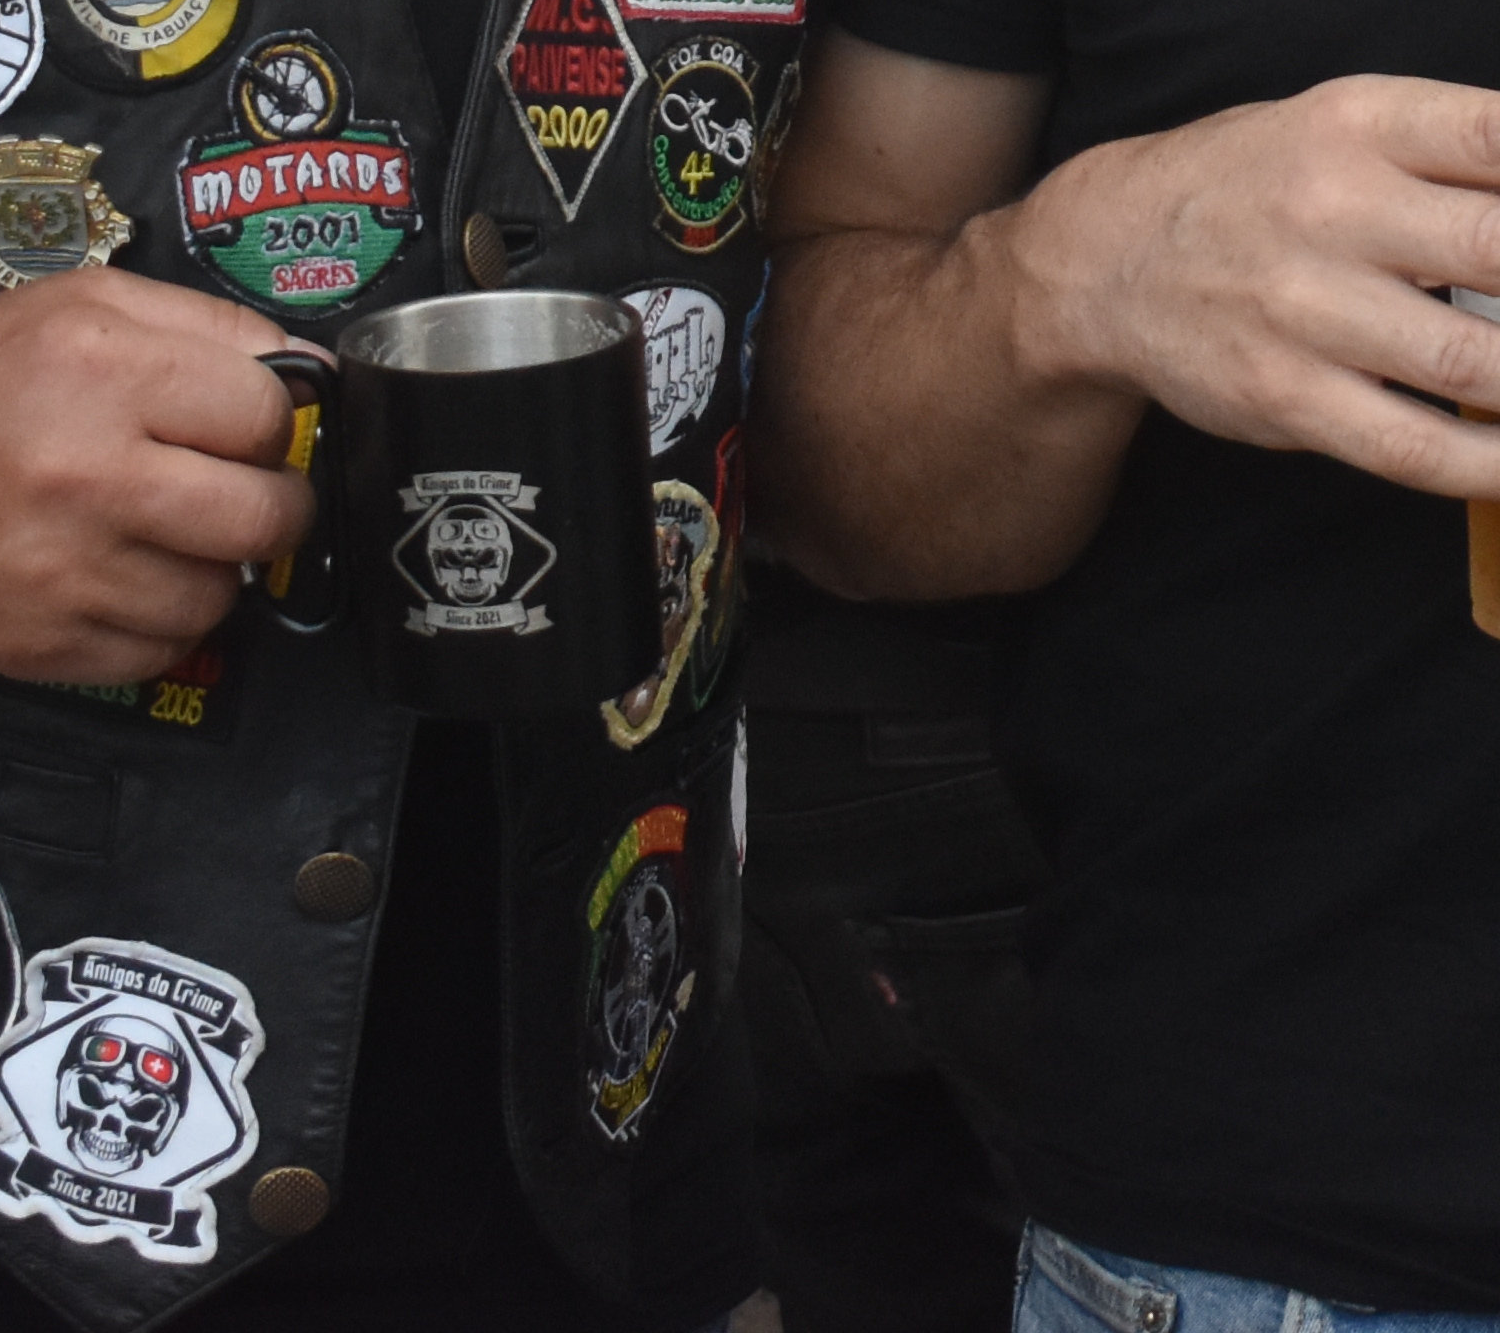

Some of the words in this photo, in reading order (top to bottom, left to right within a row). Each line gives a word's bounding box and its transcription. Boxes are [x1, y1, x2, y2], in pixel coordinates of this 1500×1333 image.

[107, 26, 131, 46] DE
[668, 44, 703, 74] FOZ
[710, 43, 745, 75] COA
[526, 104, 610, 151] 2000
[192, 150, 403, 216] MOTARDS
[263, 211, 360, 254] 2001
[272, 260, 358, 294] SAGRES
[82, 954, 145, 991] Amigos
[148, 969, 171, 993] do
[172, 977, 224, 1018] Crime
[49, 1168, 92, 1205] Since
[95, 1184, 138, 1215] 2021
